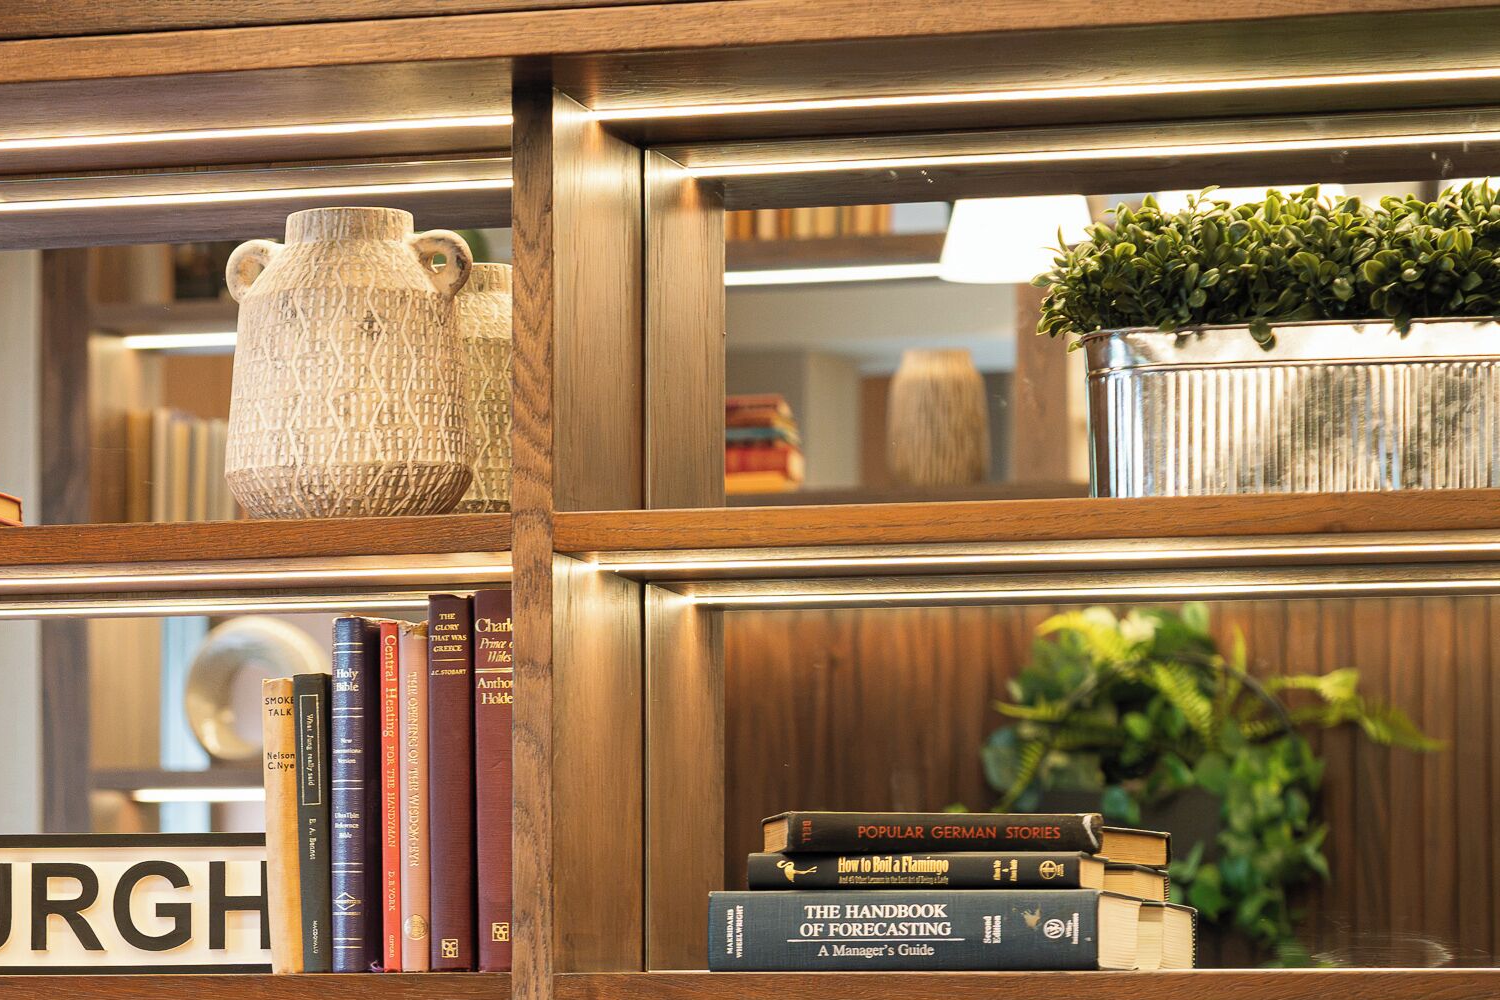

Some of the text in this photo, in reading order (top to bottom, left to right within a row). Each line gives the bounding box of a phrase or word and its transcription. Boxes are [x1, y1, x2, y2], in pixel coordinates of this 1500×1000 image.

[435, 623, 460, 631] GLORY
[430, 634, 449, 642] THAT
[479, 637, 508, 650] Prince
[336, 668, 359, 680] Holy
[336, 681, 360, 692] Bible
[265, 696, 294, 705] SMOKE
[268, 708, 292, 717] TALK
[406, 671, 420, 791] THE OPENING OF THE
[382, 635, 397, 848] Central Heating FOR THE HANDYMAN
[267, 751, 295, 760] Nelson
[305, 714, 316, 786] What Jung really said
[802, 820, 812, 843] BELL
[857, 826, 1061, 839] POPULAR GERMAN STORIES
[837, 855, 949, 875] How to Boil a Flamingo
[803, 904, 948, 919] THE HANDBOOK
[726, 909, 734, 955] MAKRIDAKIS
[736, 904, 744, 959] WHEELWRIGHT
[799, 922, 952, 937] OF FORECASTING
[983, 916, 993, 944] Second
[992, 915, 1002, 944] Edition
[817, 943, 935, 958] A Manager's Guide
